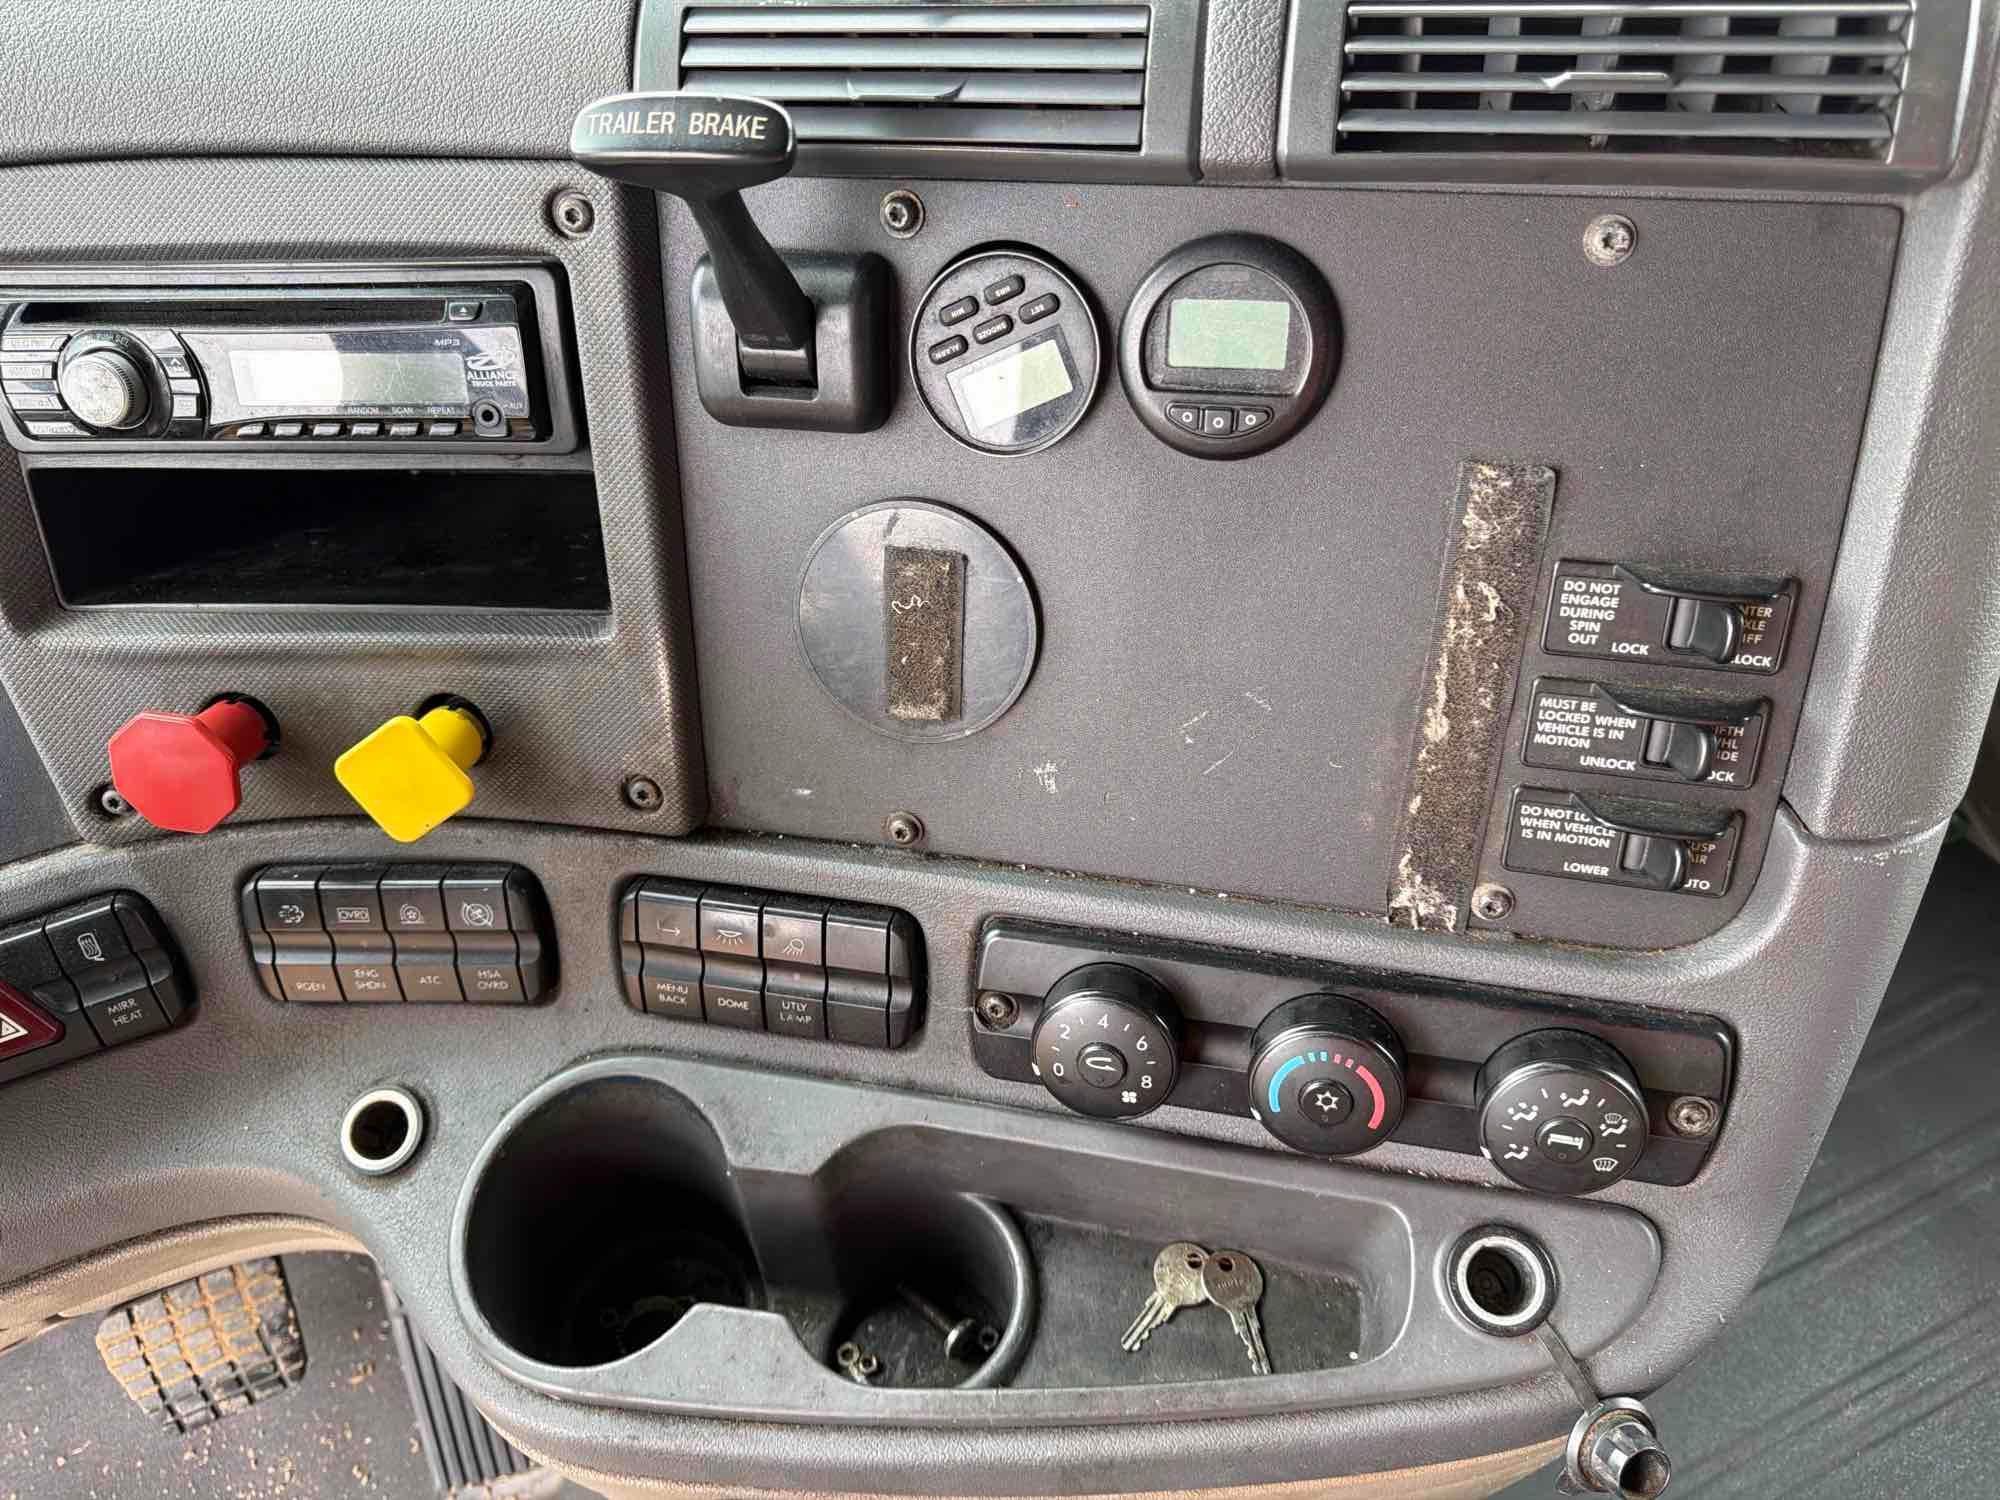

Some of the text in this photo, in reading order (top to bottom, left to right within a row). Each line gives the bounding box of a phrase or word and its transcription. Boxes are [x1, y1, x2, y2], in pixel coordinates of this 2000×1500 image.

[586, 111, 768, 140] TRAILER BRAKE
[434, 338, 460, 346] MP3
[1563, 580, 1622, 595] DO NOT
[1560, 593, 1620, 608] ENGAGE
[1559, 606, 1616, 621] DURING
[1569, 619, 1601, 633] SPIN
[1744, 619, 1767, 631] XLE
[1567, 633, 1599, 646] OUT
[1611, 642, 1649, 656] LOCK
[1731, 654, 1773, 668] LOCK
[1539, 697, 1598, 713] MUST BE
[1538, 709, 1637, 729] LOCKED WHEN
[1536, 721, 1625, 740] VEHICLE IS IN
[1533, 734, 1591, 749] MOTION
[1579, 755, 1637, 771] UNLOCK
[1706, 770, 1736, 783] OCK
[1520, 805, 1542, 816] DO
[1543, 808, 1573, 820] NOT
[1520, 817, 1561, 830] WHEN
[1564, 822, 1617, 837] VEHICLE
[1521, 828, 1610, 848] IS IN MOTION
[1563, 861, 1609, 876] LOWER
[338, 910, 369, 920] OVRD
[419, 976, 441, 985] ATC
[656, 983, 689, 995] MENU
[658, 993, 687, 1005] BACK
[717, 997, 750, 1010] DOME
[782, 1000, 808, 1012] UTLY
[107, 998, 138, 1016] MIRR
[111, 1009, 143, 1027] HEAT
[779, 1012, 813, 1025] LAMP
[1053, 1013, 1153, 1089] 0 2 4 6 8
